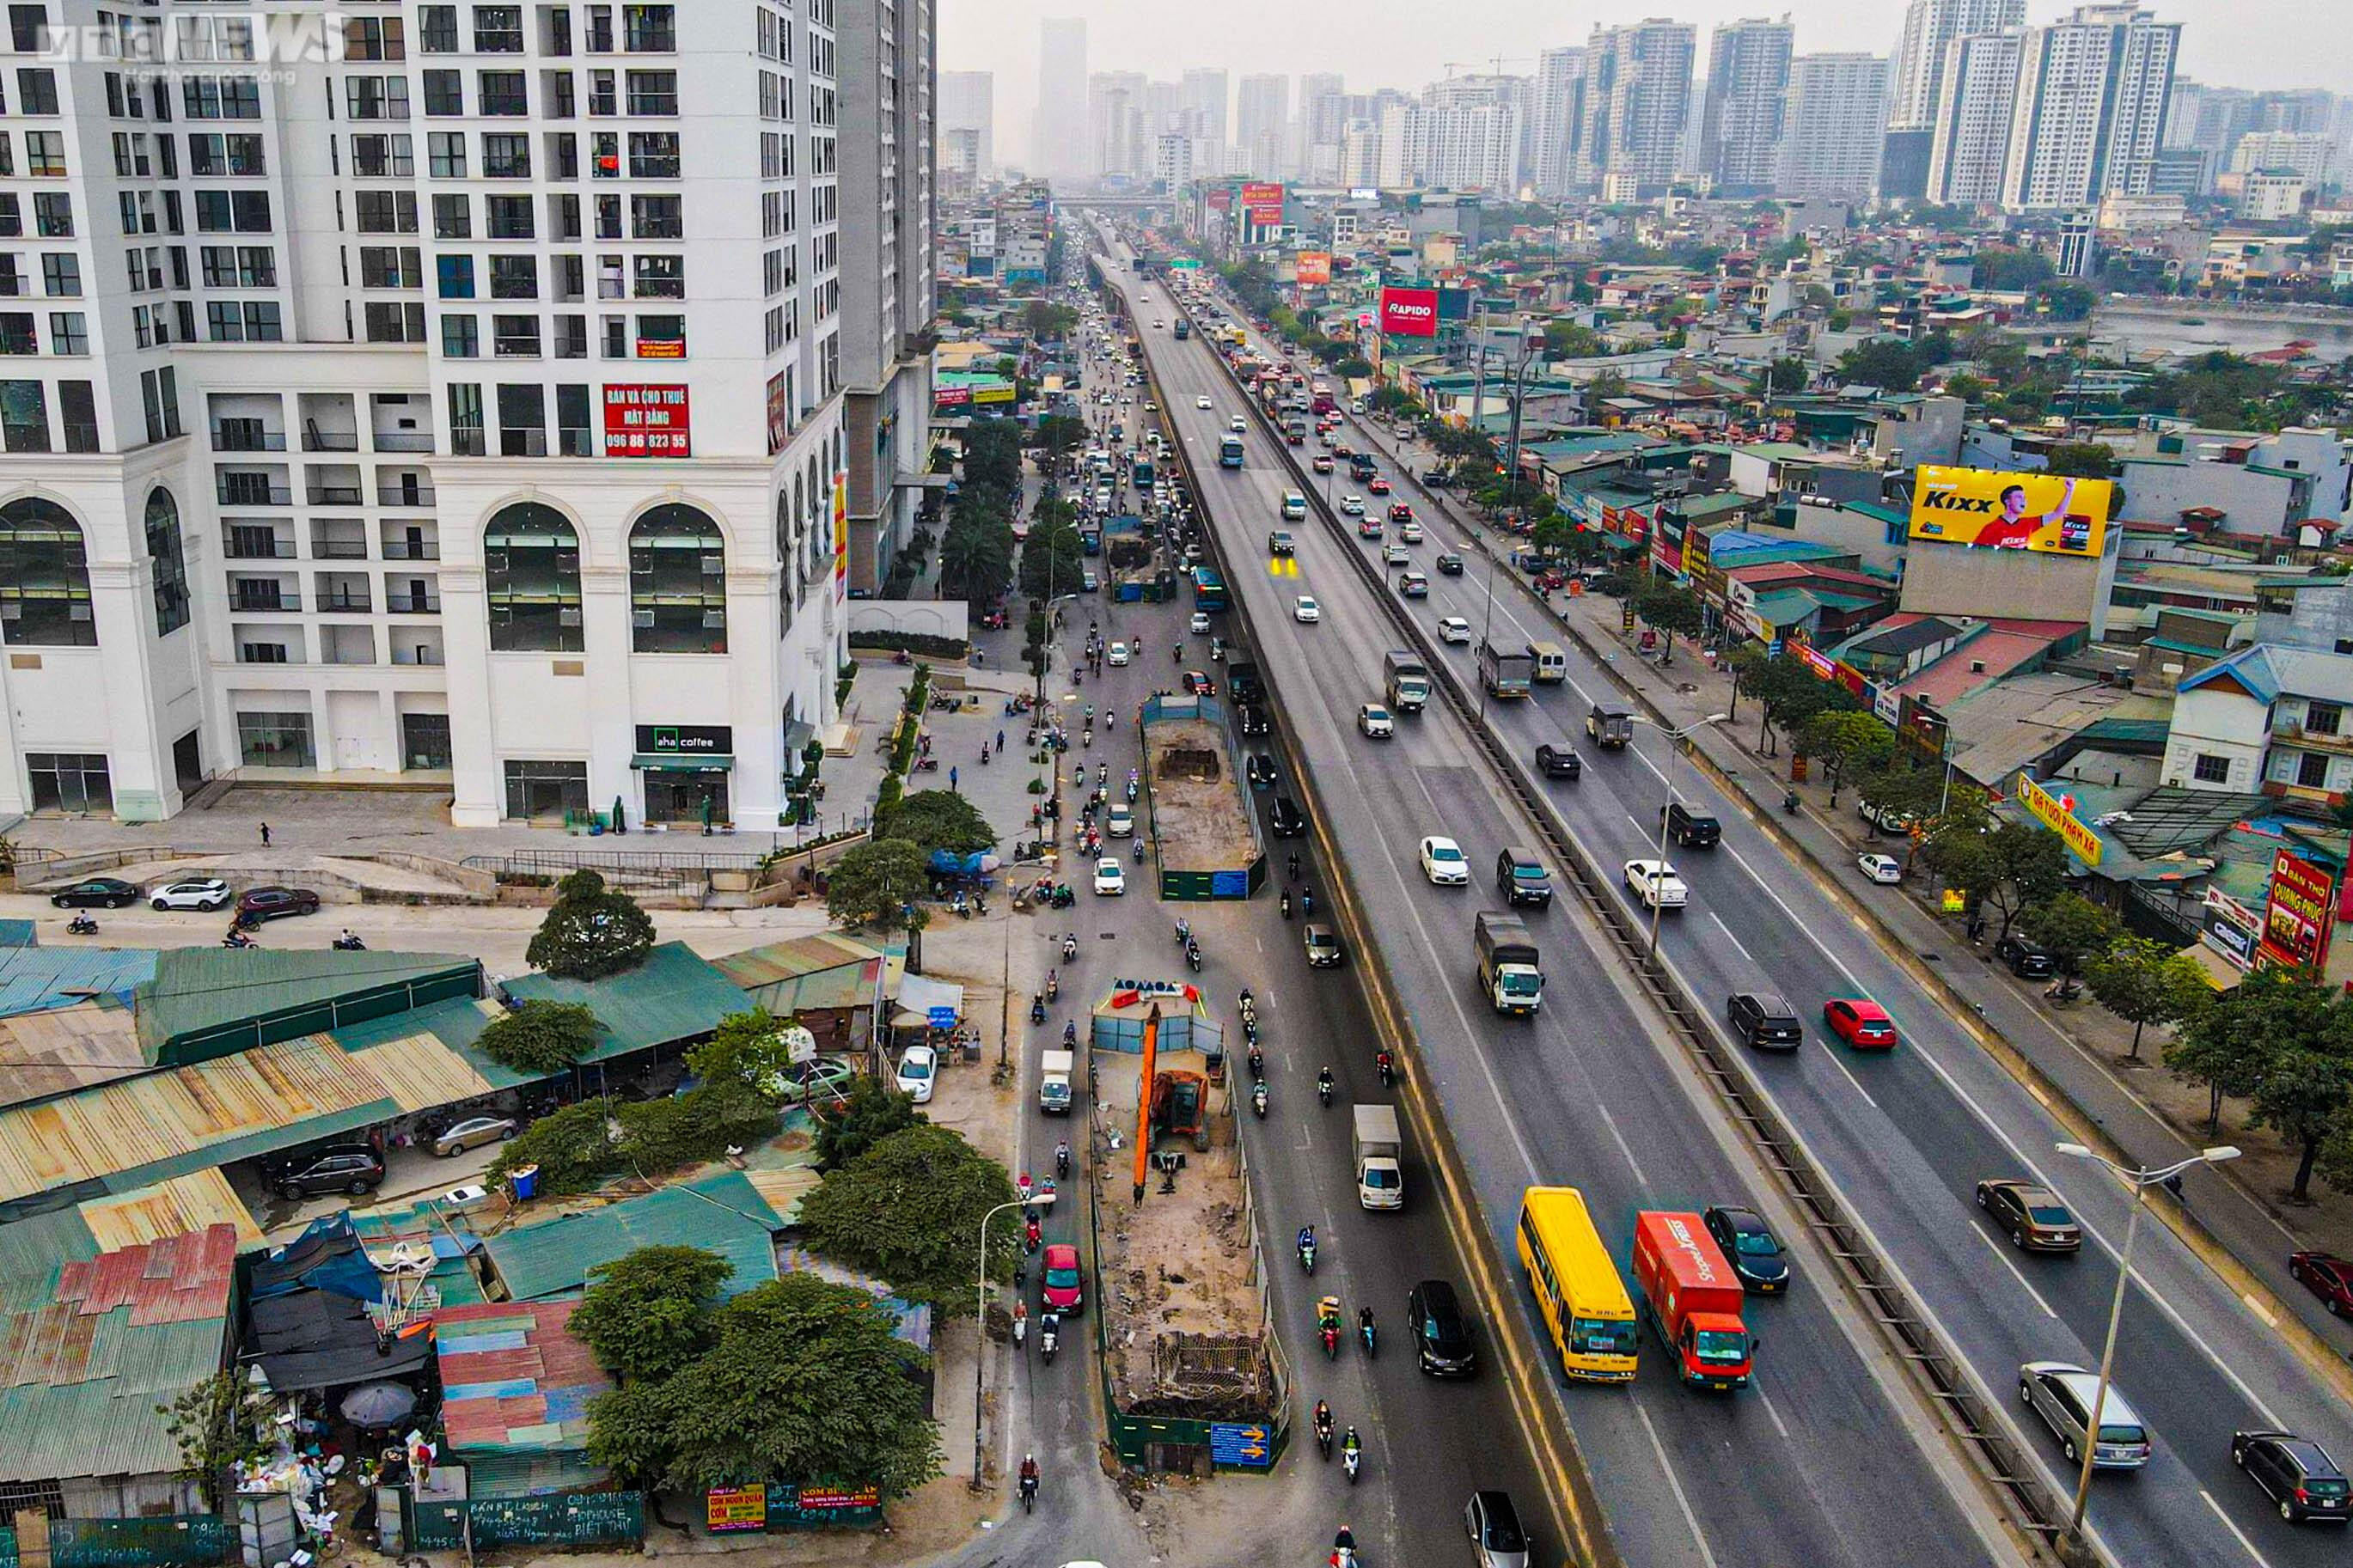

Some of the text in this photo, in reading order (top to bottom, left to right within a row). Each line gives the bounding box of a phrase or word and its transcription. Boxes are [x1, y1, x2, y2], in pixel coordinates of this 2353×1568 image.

[1388, 302, 1431, 316] RAPIDO
[608, 388, 685, 404] BÁN VÀ CHO THUÊ
[607, 433, 686, 448] 096 86 823 55
[1923, 491, 1995, 513] Kixx
[2064, 522, 2088, 530] Kixx
[657, 735, 714, 747] aha coffee
[2274, 882, 2302, 912] QUANG
